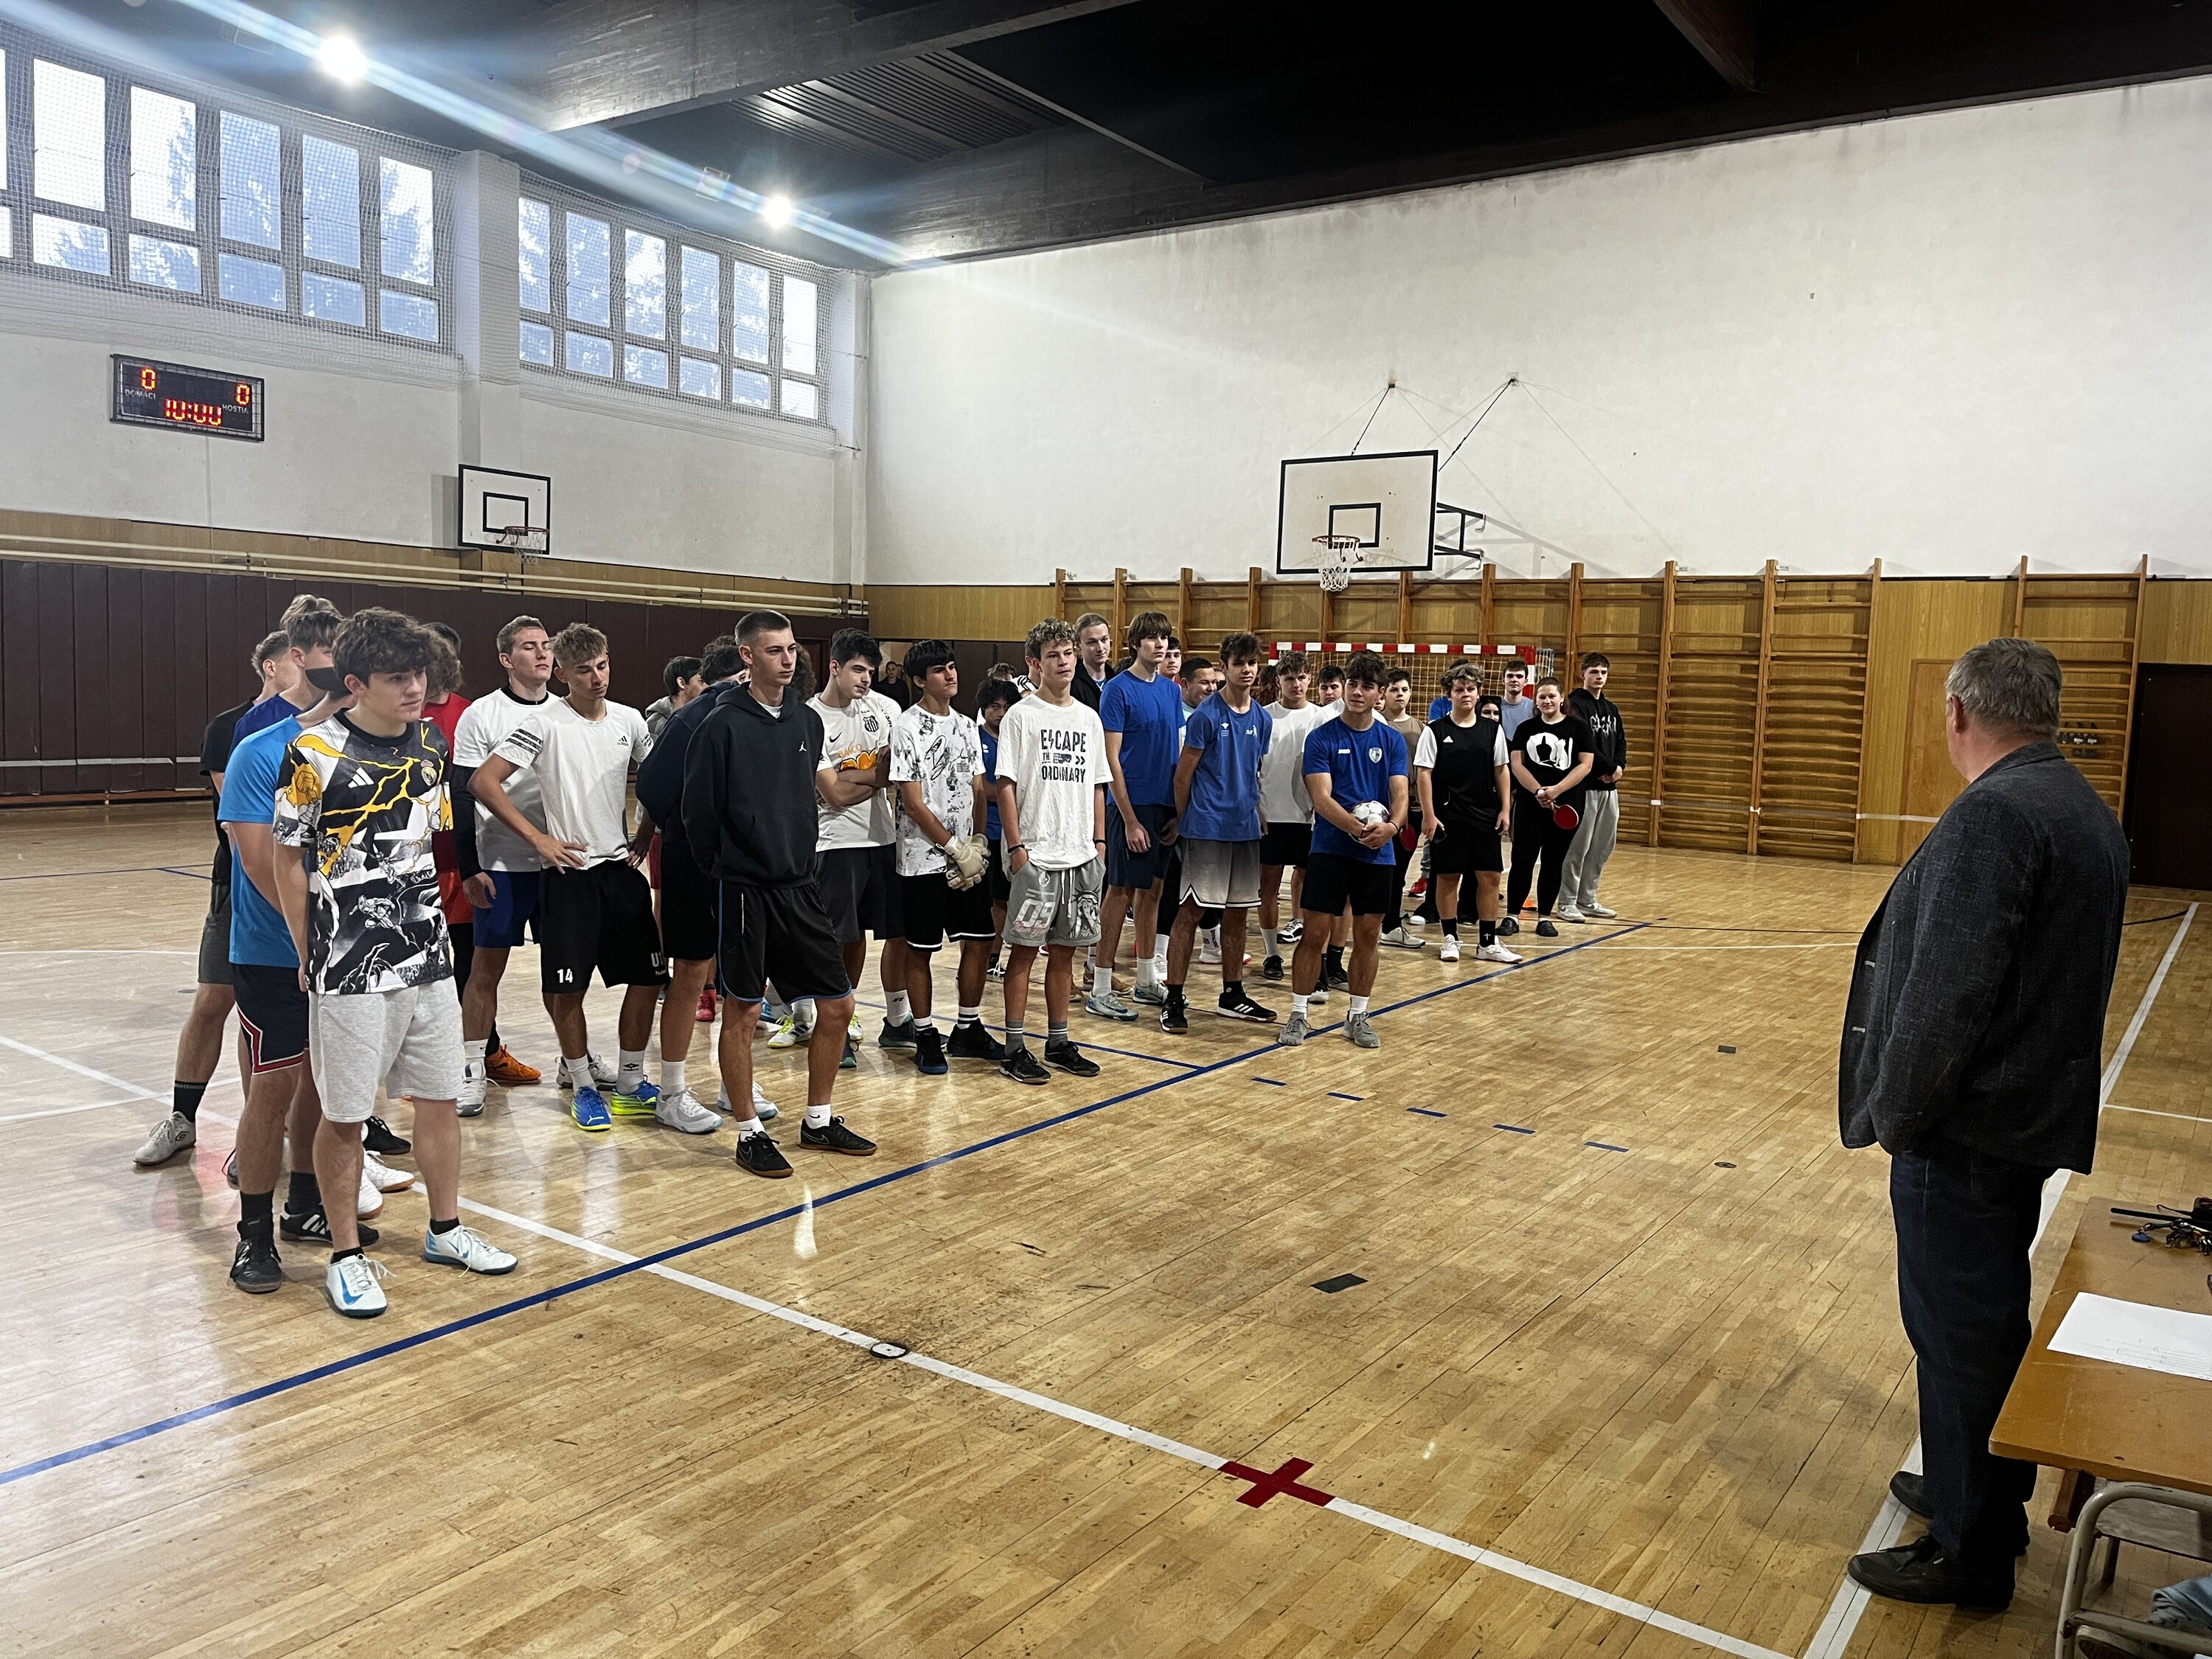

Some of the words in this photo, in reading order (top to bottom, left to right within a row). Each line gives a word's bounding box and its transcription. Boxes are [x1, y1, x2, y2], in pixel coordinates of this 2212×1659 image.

[142, 368, 156, 390] 0
[235, 383, 251, 406] 0
[165, 398, 222, 426] 10:00
[222, 403, 249, 414] HOSTIA
[1041, 765, 1086, 783] ORDINARY
[557, 968, 574, 984] 14
